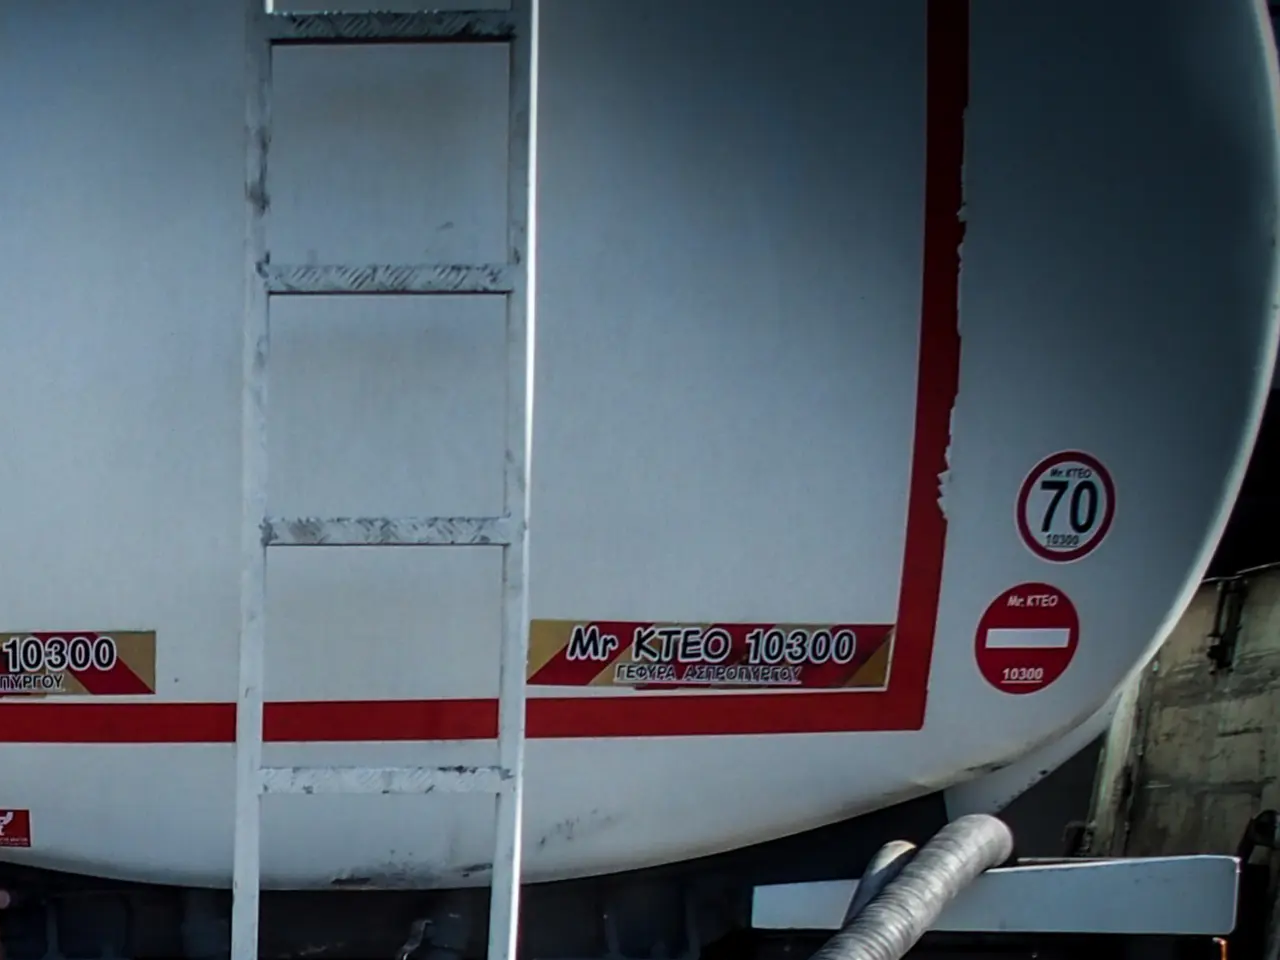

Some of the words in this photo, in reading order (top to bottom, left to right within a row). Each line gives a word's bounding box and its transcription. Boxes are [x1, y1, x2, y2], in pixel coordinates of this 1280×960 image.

[1040, 480, 1098, 533] 70
[1046, 534, 1079, 546] 10300
[3, 636, 118, 672] 10300
[566, 625, 619, 663] Mr
[745, 628, 857, 666] 10300
[1001, 667, 1044, 681] 10300
